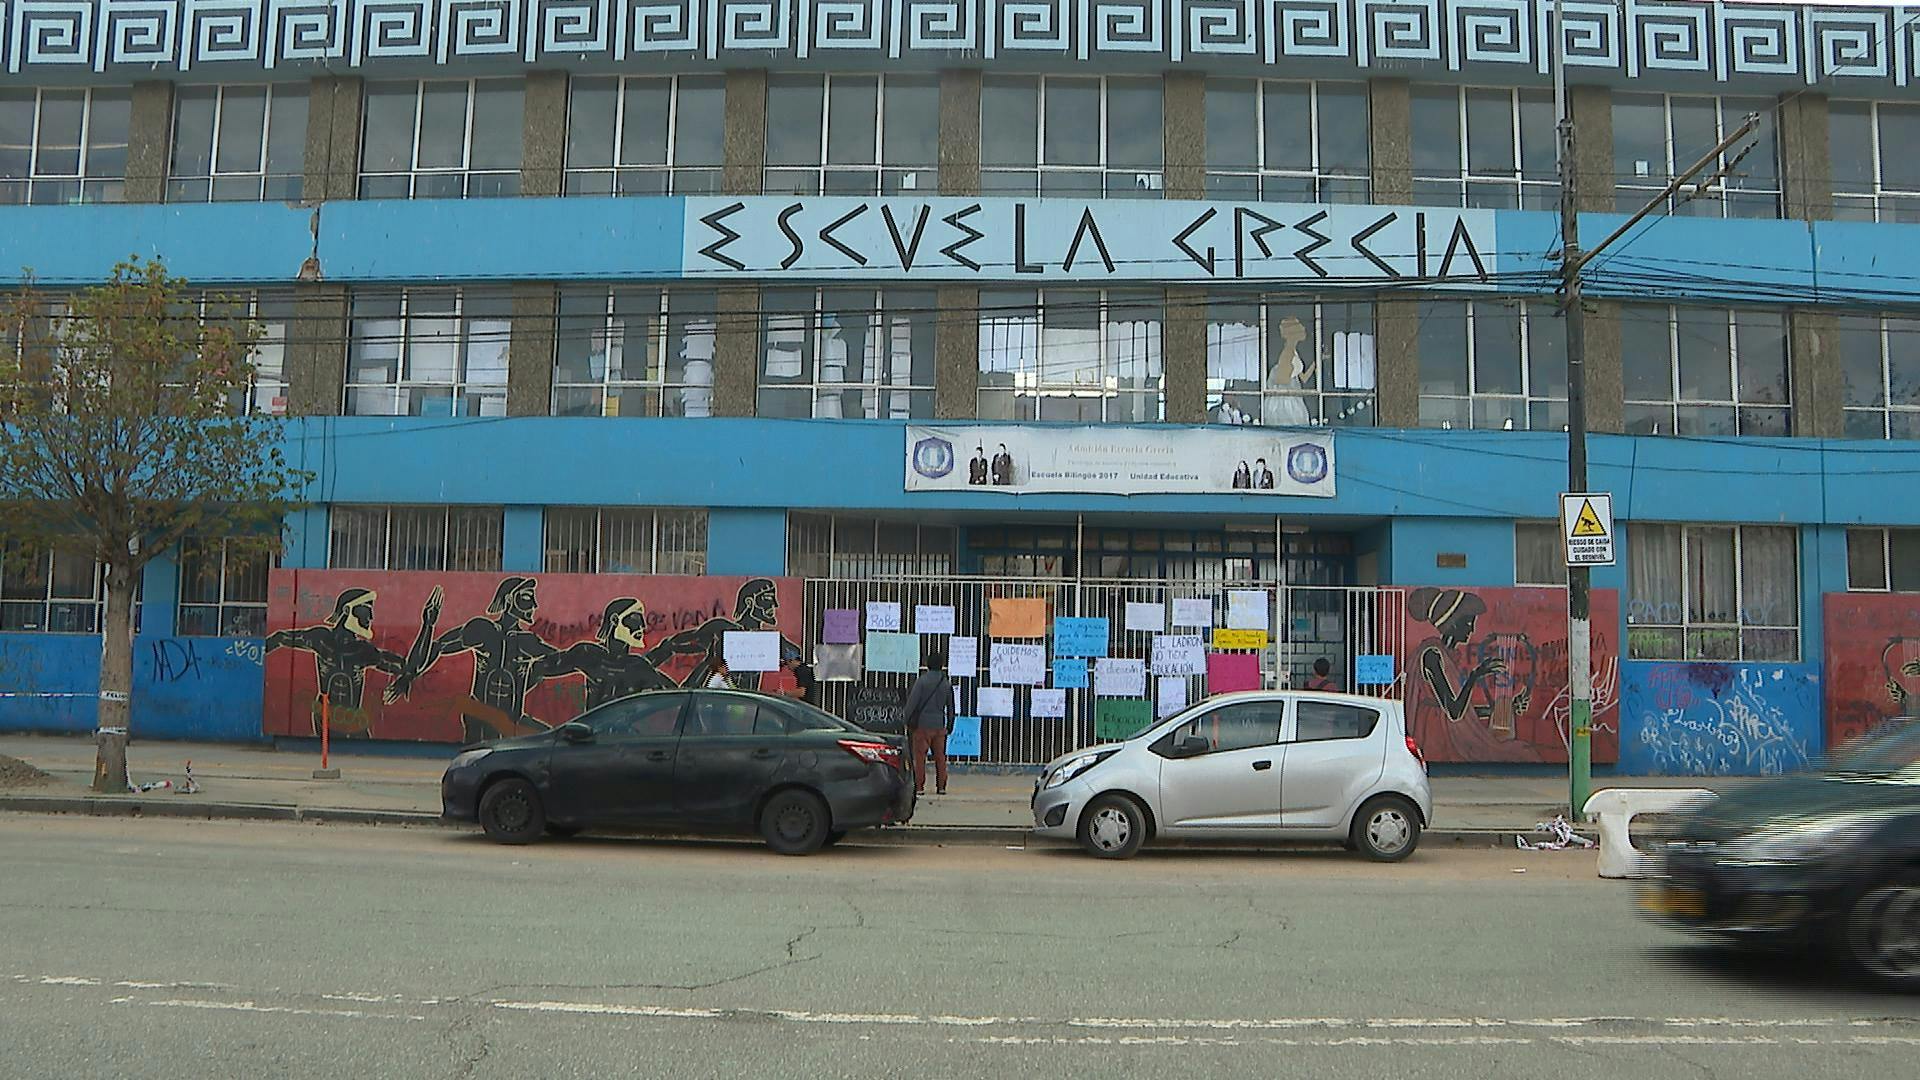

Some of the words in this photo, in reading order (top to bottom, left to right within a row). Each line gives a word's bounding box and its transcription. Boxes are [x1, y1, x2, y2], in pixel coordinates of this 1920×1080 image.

[1172, 206, 1490, 282] GRECIA
[1031, 471, 1063, 480] Escuela
[1098, 472, 1119, 480] 2017
[1130, 473, 1158, 481] Unidad
[1159, 473, 1199, 481] Educativa
[1153, 637, 1166, 649] EL
[996, 646, 1039, 657] CUIDEMOS
[1152, 650, 1164, 662] NO
[1168, 650, 1189, 661] TIENE
[1010, 655, 1020, 665] LA
